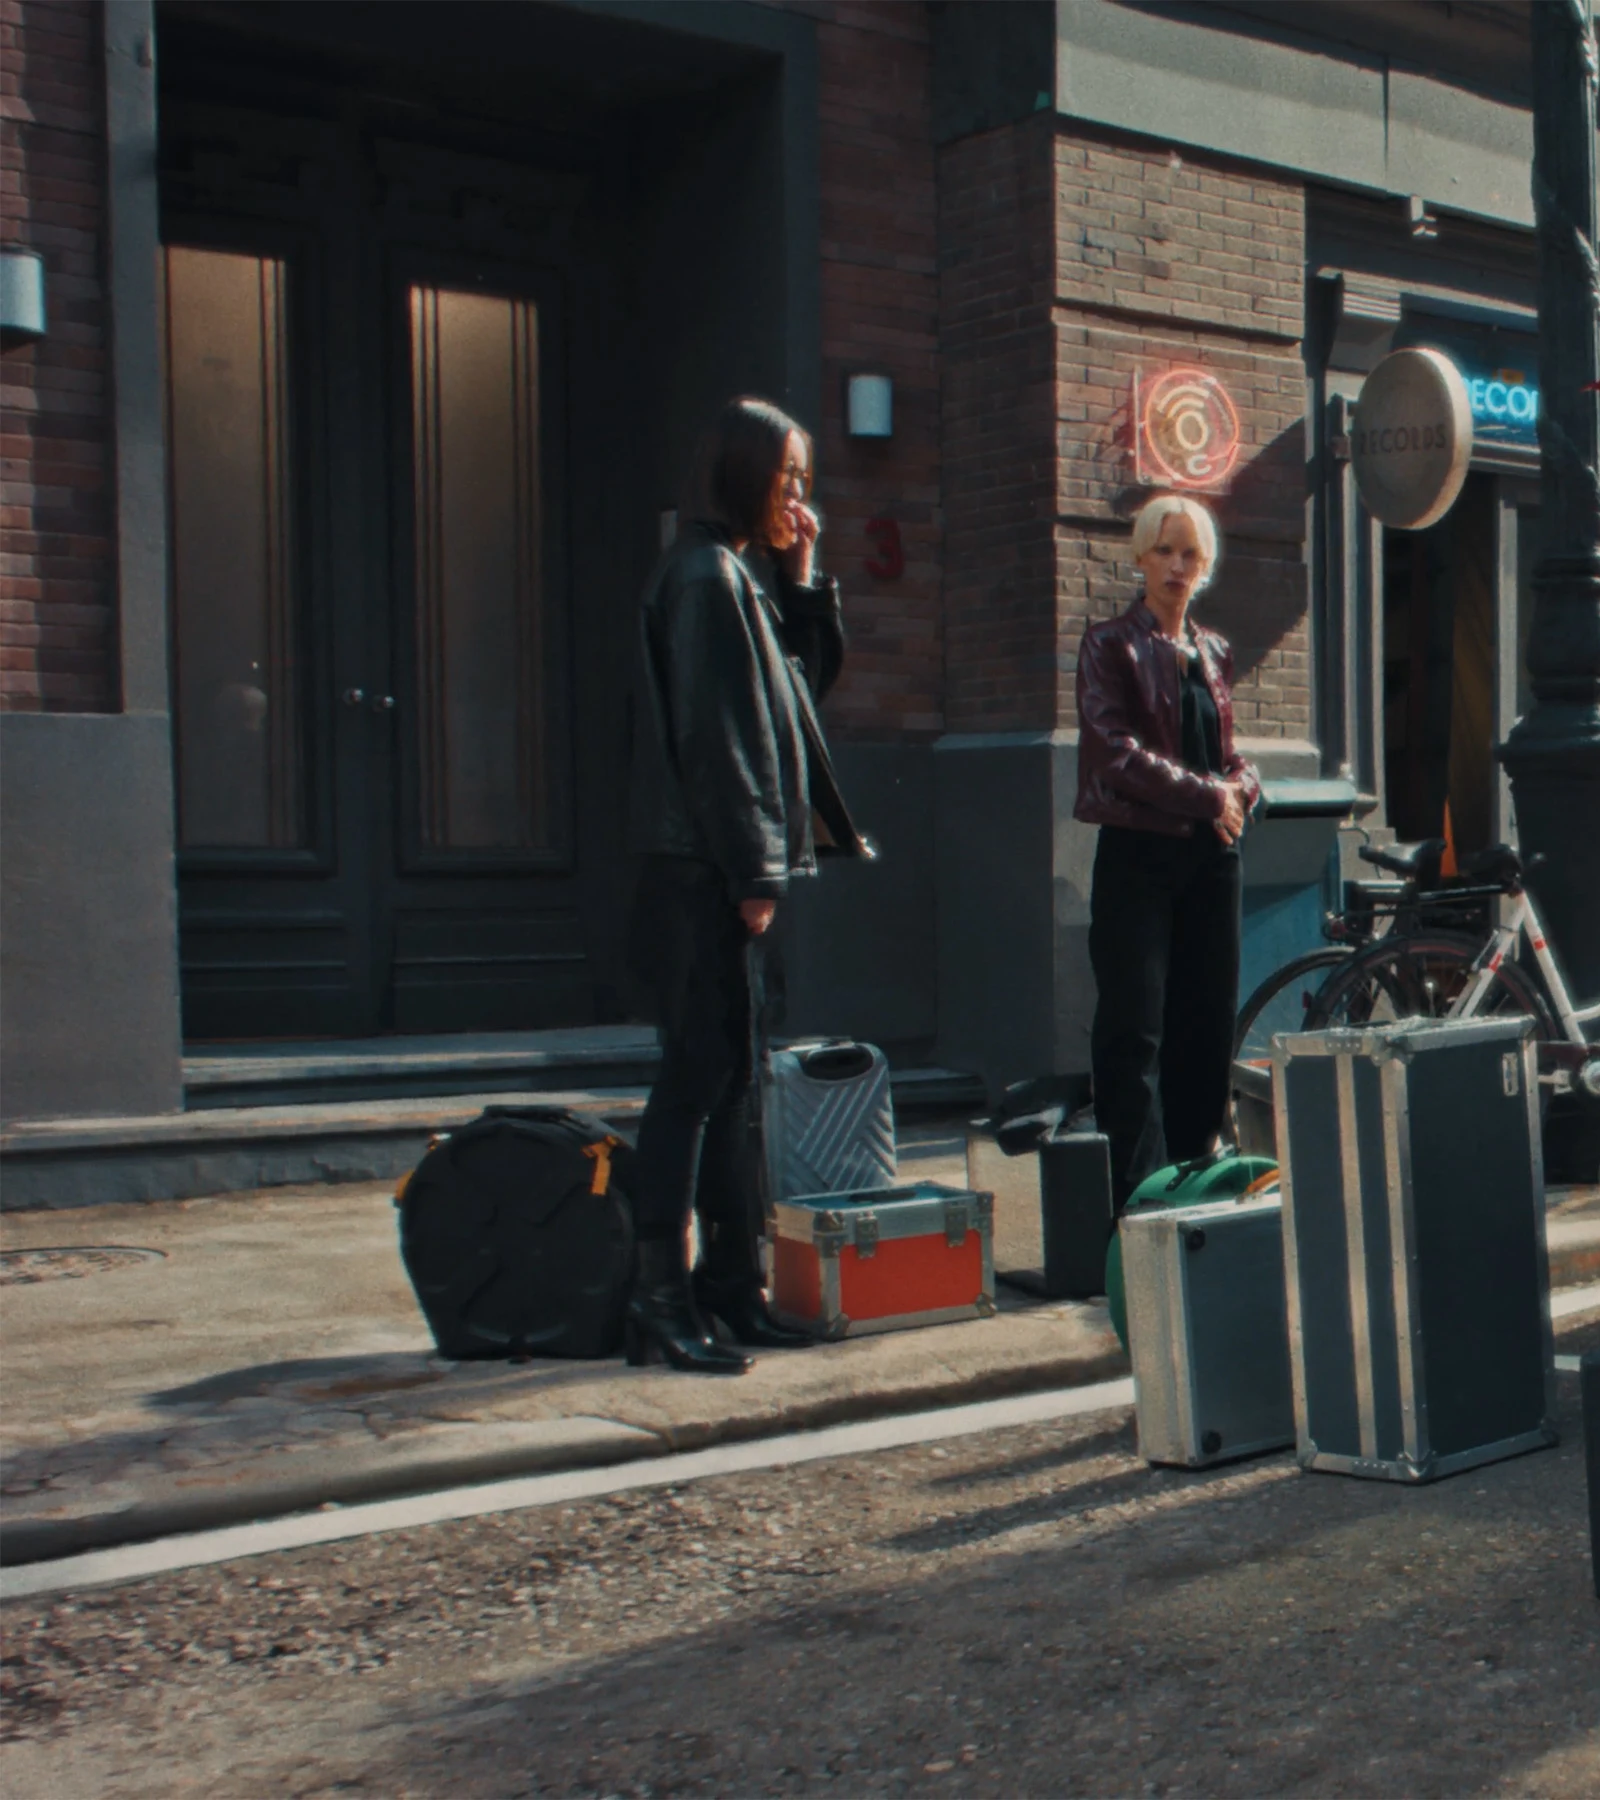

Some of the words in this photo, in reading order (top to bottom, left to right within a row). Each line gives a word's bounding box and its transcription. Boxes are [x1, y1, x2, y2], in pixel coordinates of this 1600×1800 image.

[1463, 377, 1539, 420] ECO
[1359, 423, 1446, 456] RECORDS
[865, 517, 904, 579] 3
